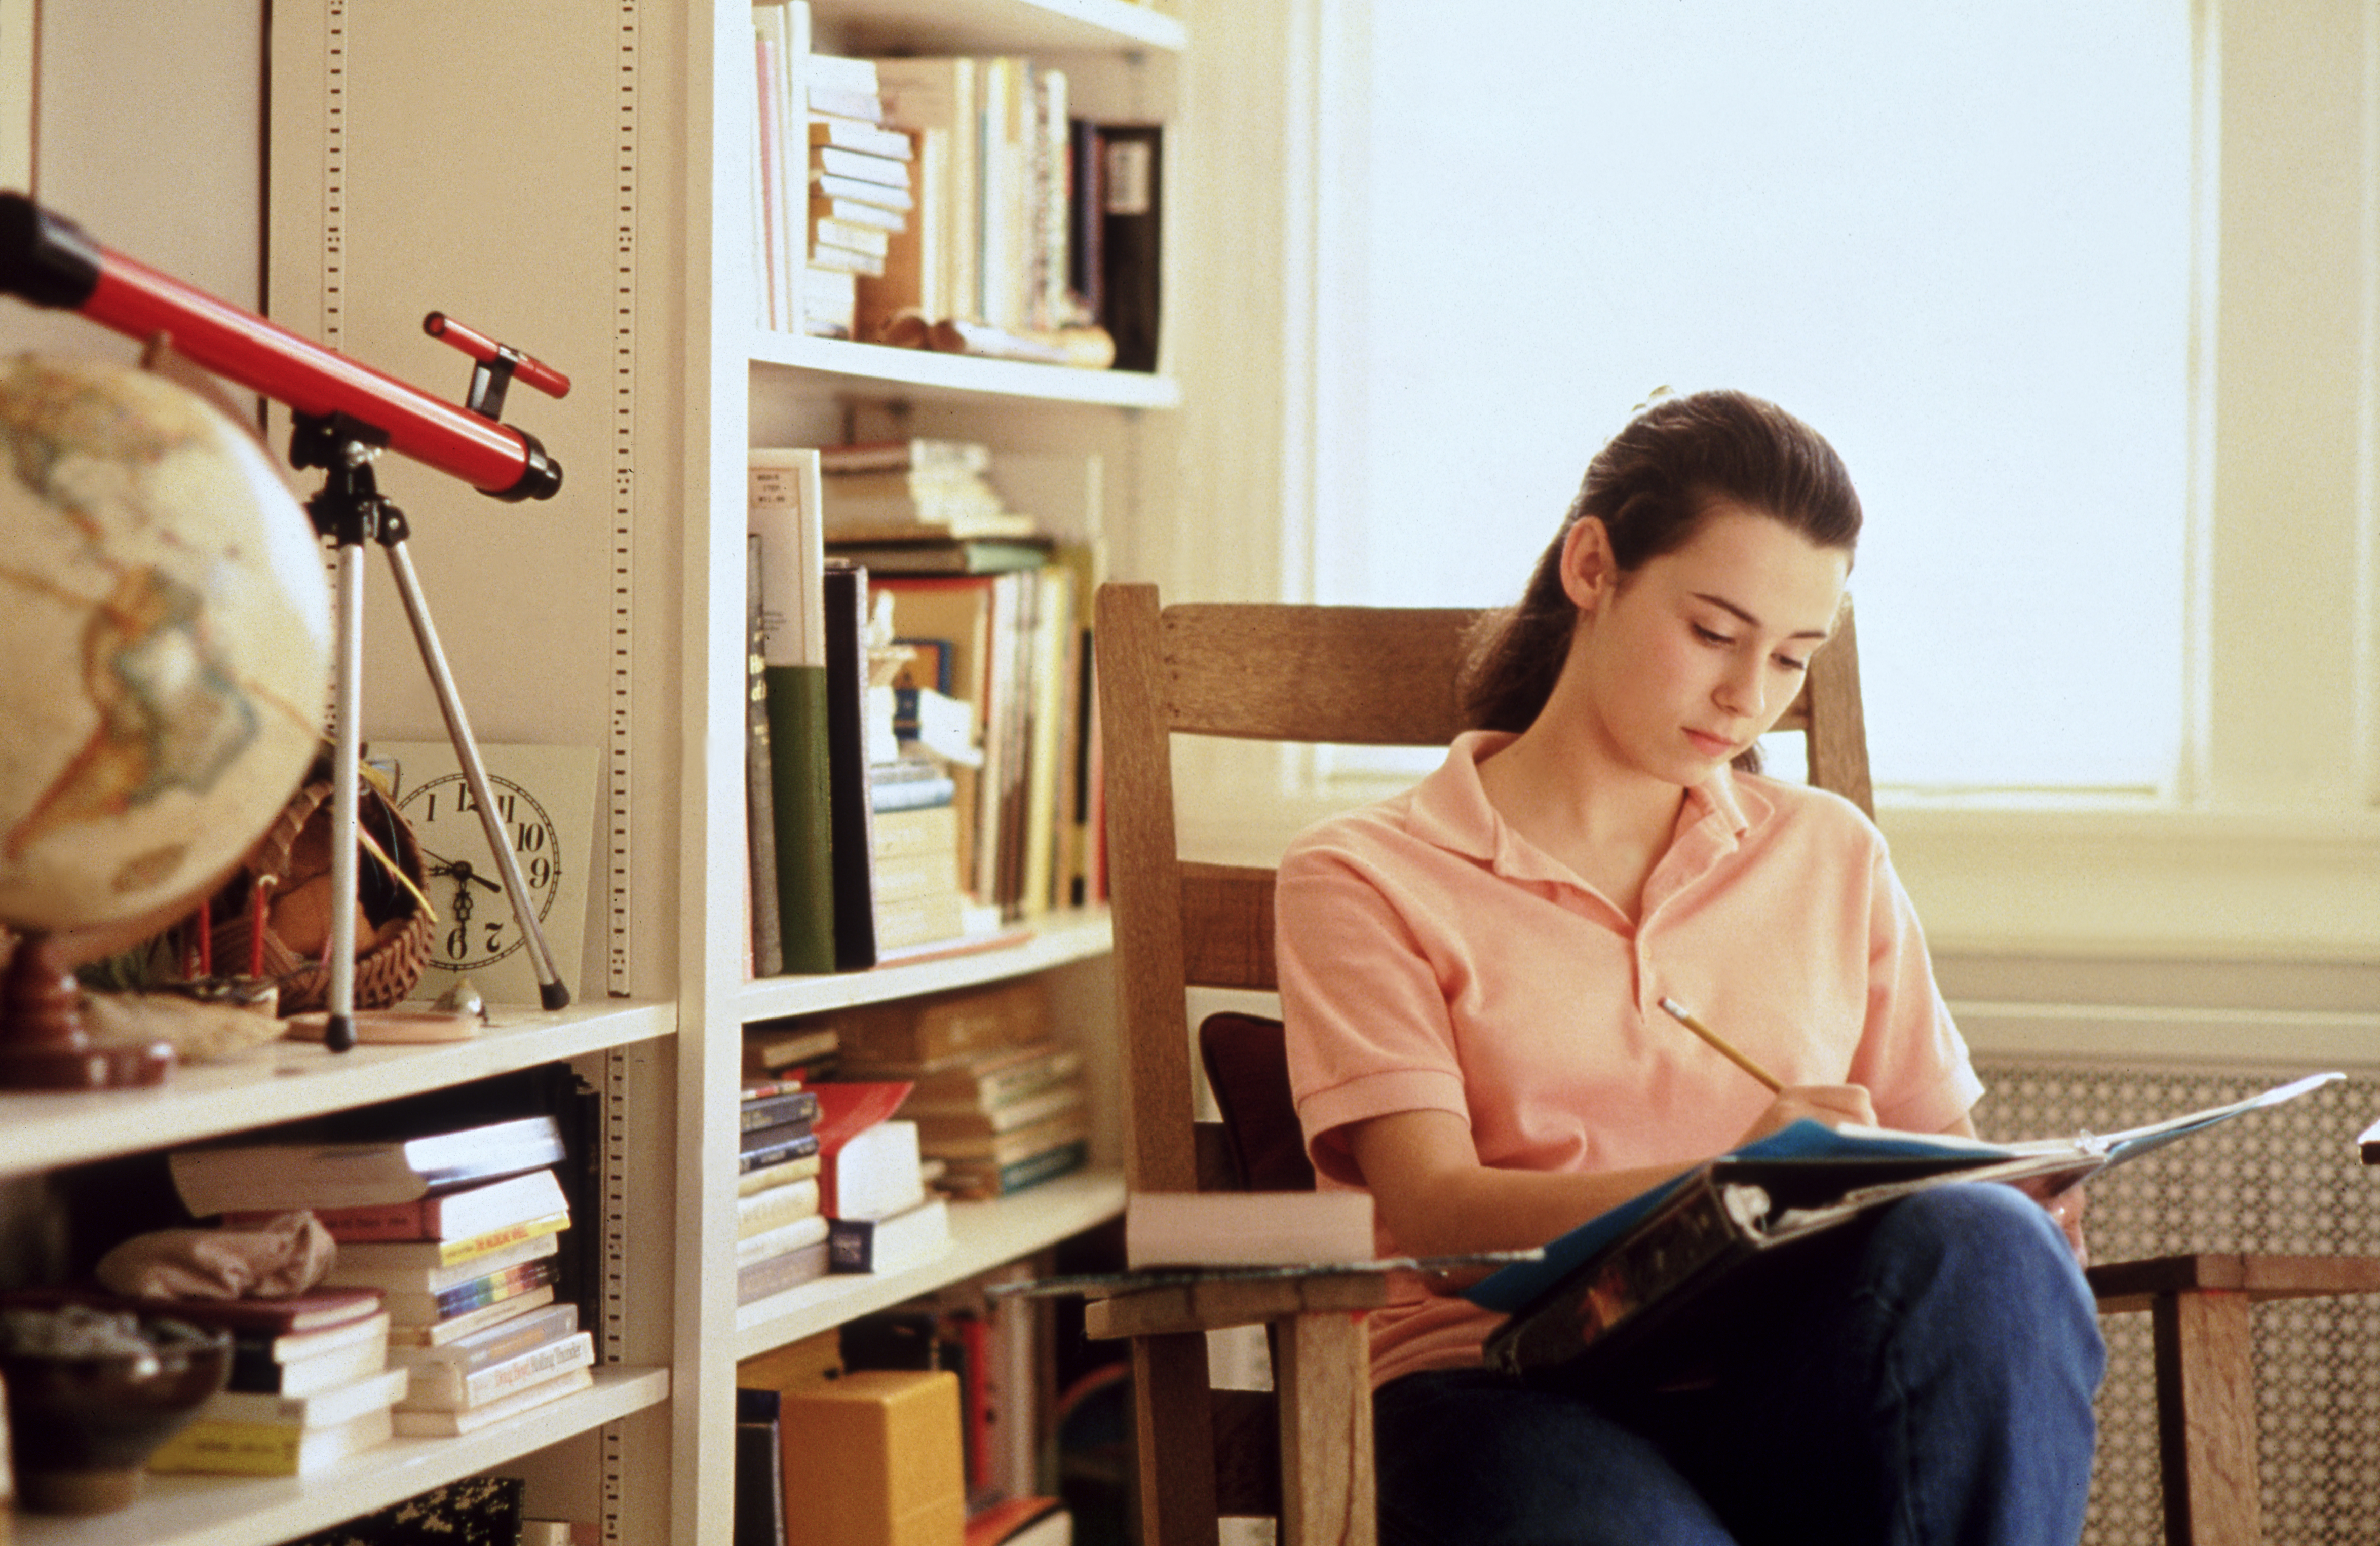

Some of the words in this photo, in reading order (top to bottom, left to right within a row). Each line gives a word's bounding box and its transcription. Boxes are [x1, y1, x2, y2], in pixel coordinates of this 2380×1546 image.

[426, 794, 436, 822] 1
[498, 795, 515, 823] 11
[516, 822, 544, 852] 10
[529, 857, 550, 889] 9
[447, 927, 467, 960] 6
